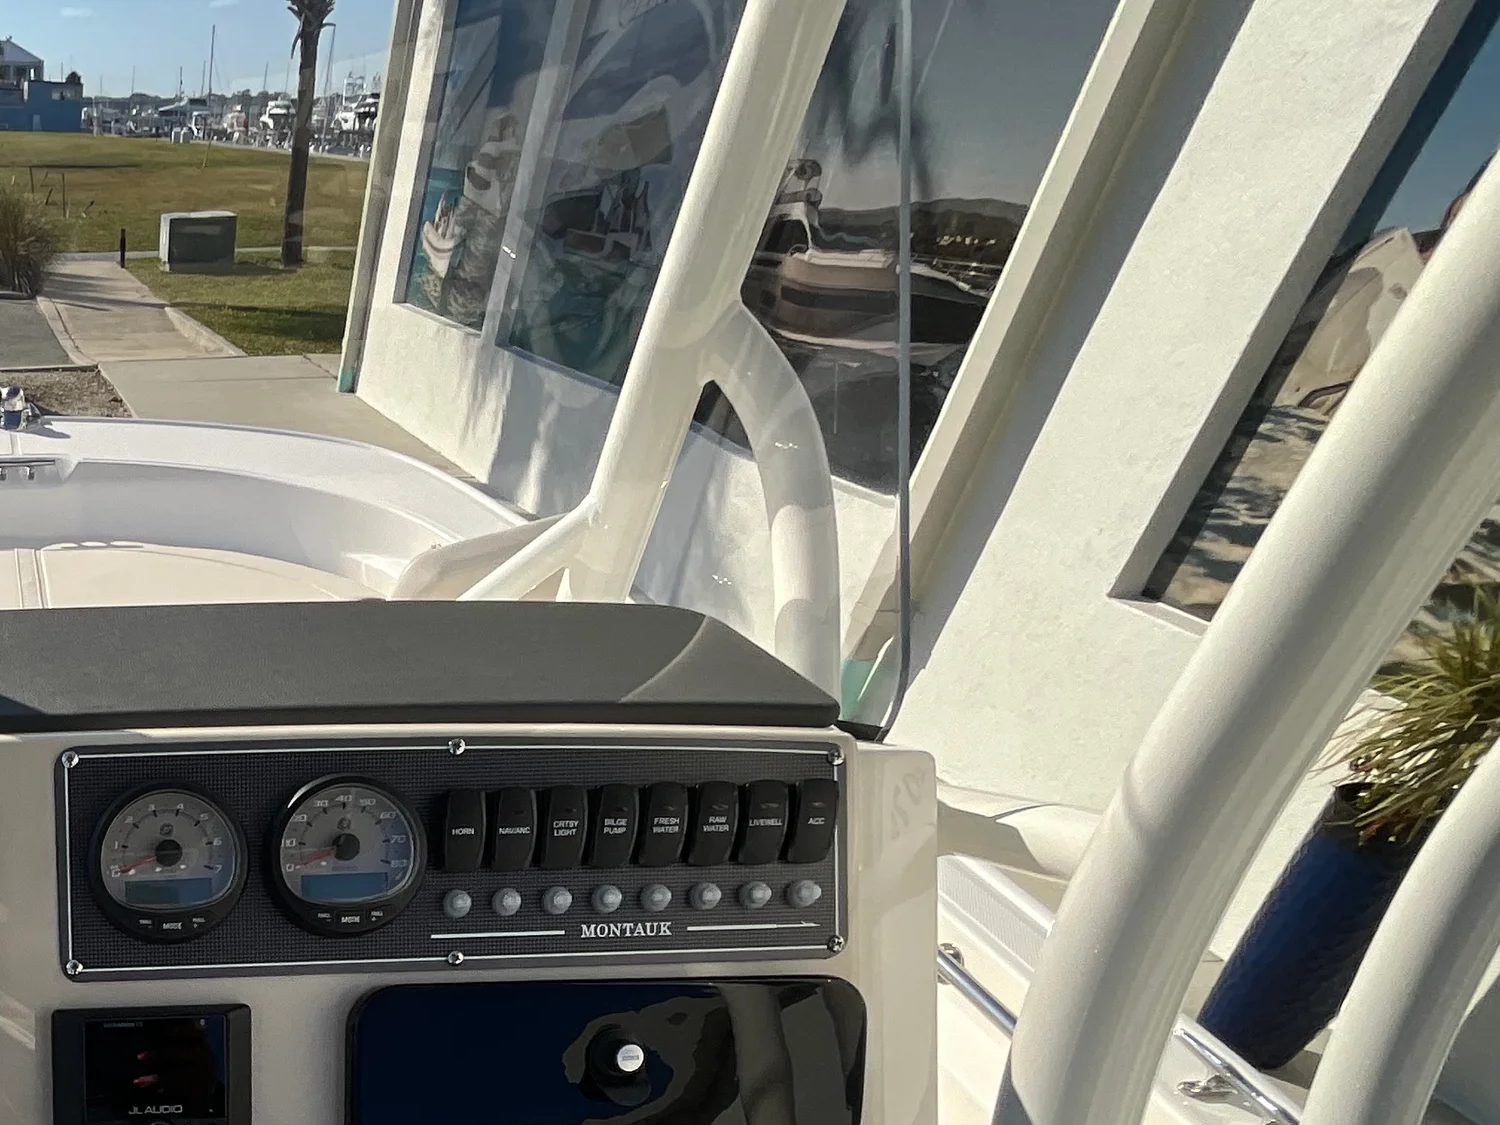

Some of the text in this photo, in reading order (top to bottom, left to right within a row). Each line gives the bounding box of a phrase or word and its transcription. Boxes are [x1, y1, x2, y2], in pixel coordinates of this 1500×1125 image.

[200, 813, 209, 821] 5
[380, 811, 396, 819] 60
[125, 816, 134, 824] 2
[553, 820, 579, 828] CRTSY
[604, 818, 628, 826] BILGE
[653, 817, 680, 825] FRESH
[708, 816, 728, 824] RAW
[749, 818, 783, 827] LIVEWELL
[807, 817, 826, 825] ACC
[452, 828, 475, 836] HORN
[554, 828, 577, 837] LIGHT
[604, 826, 627, 835] PUMP
[653, 825, 679, 834] WATER
[703, 824, 730, 833] WATER
[213, 837, 222, 846] 6
[390, 835, 406, 844] 70
[213, 864, 223, 874] 7
[580, 921, 673, 938] MONTAUK
[128, 1104, 184, 1115] JL AUDIO
